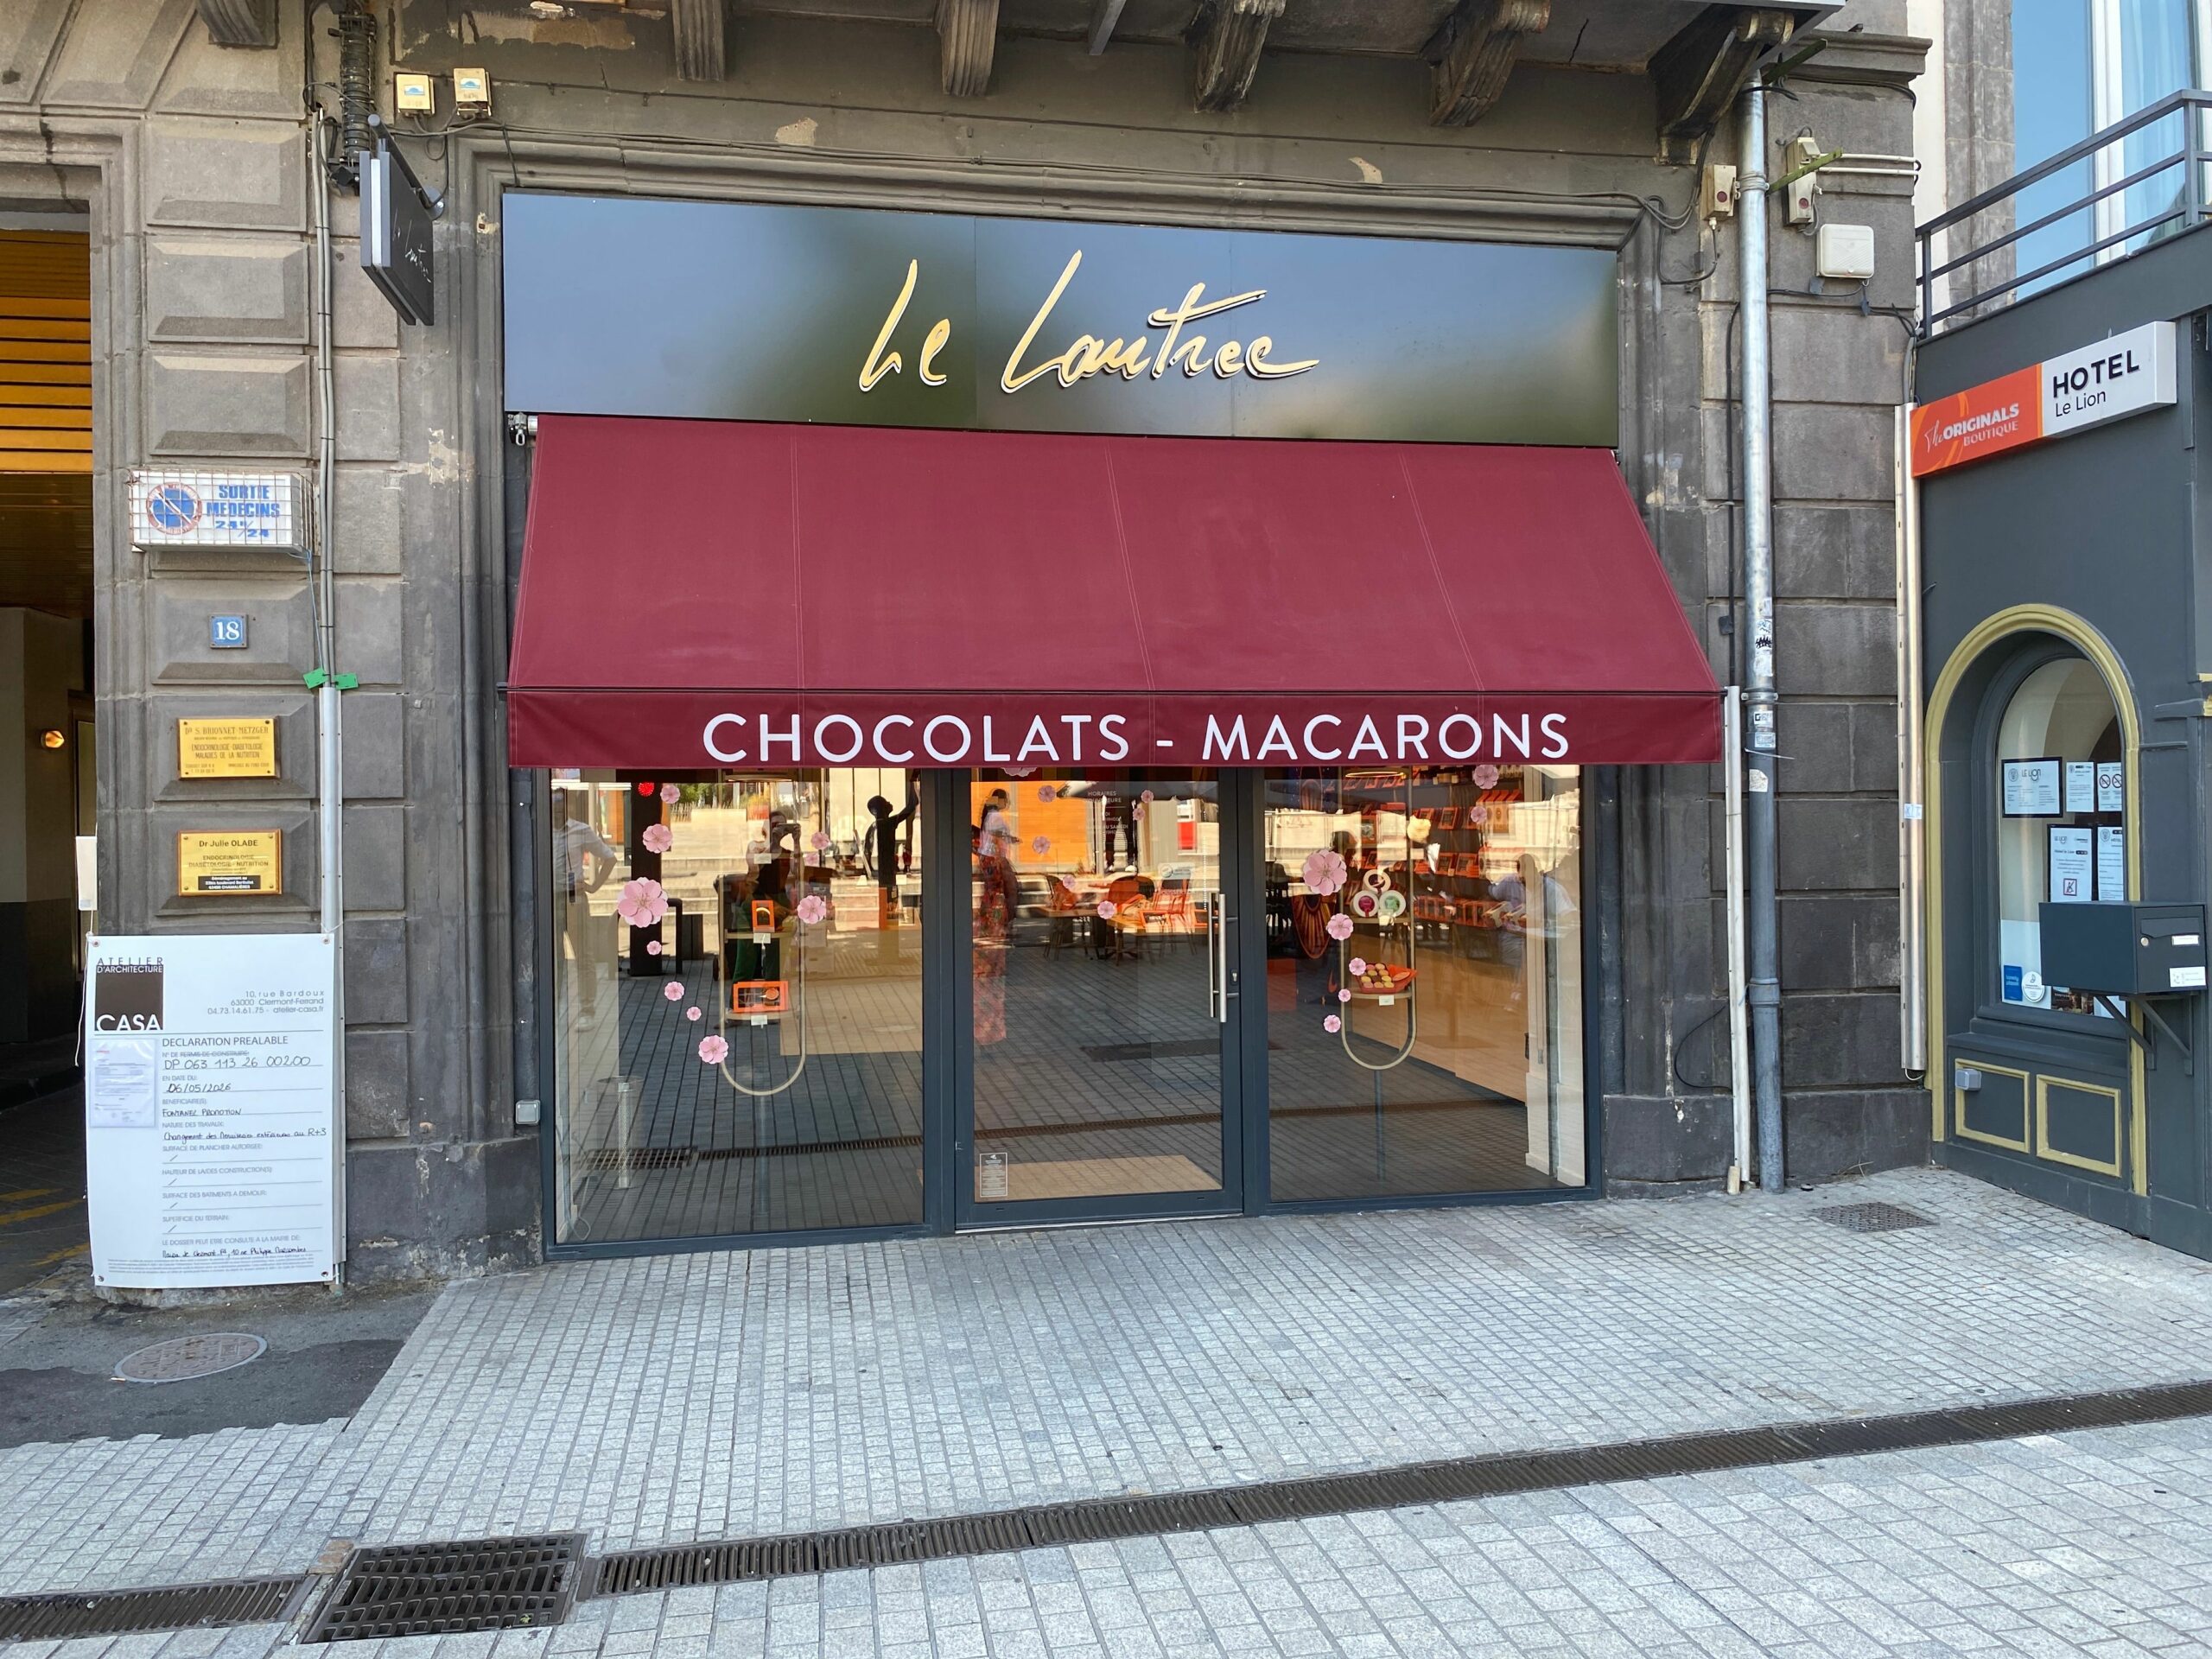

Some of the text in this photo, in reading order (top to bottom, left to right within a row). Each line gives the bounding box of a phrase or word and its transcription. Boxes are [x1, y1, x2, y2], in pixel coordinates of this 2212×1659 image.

[858, 258, 950, 391] Le
[2053, 349, 2139, 398] HOTEL
[2056, 390, 2107, 417] Le Lion
[1943, 403, 2020, 441] ORIGINALS
[1963, 420, 2019, 447] BOUTIQUE
[219, 485, 270, 499] SORTIE
[206, 502, 281, 518] MEDECINS
[215, 621, 240, 640] 18
[702, 713, 1129, 763] CHOCOLATS
[1202, 713, 1569, 761] MACARONS
[96, 1014, 162, 1031] CASA
[162, 1036, 289, 1046] DECLARATION PREALABLE
[164, 1055, 311, 1070] DP 063 113 26 00200
[308, 1128, 327, 1136] R+3
